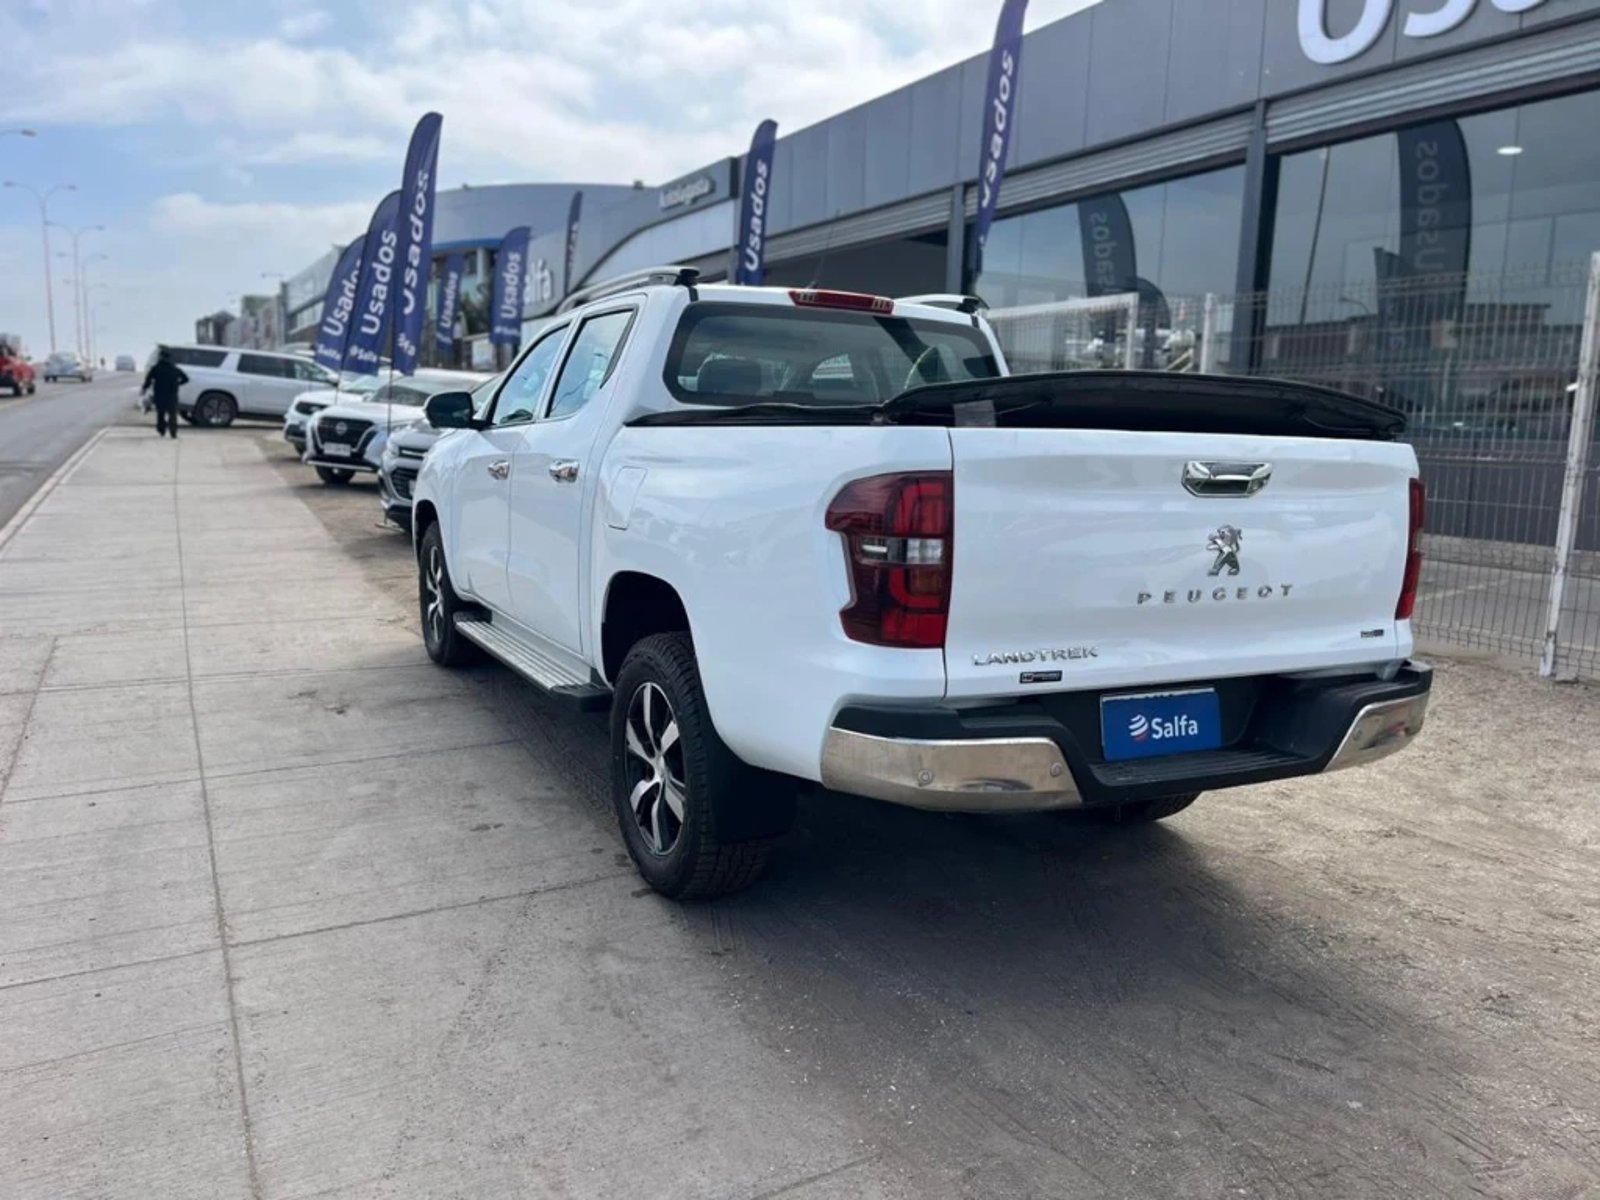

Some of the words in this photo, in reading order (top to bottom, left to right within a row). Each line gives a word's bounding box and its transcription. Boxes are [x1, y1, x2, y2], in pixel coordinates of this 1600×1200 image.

[744, 159, 768, 271] Usados
[361, 230, 398, 335] Usados
[500, 251, 521, 319] Usados
[1136, 584, 1294, 605] PEUGEOT
[972, 646, 1100, 666] LANDTREK
[1151, 714, 1199, 741] Salfa
